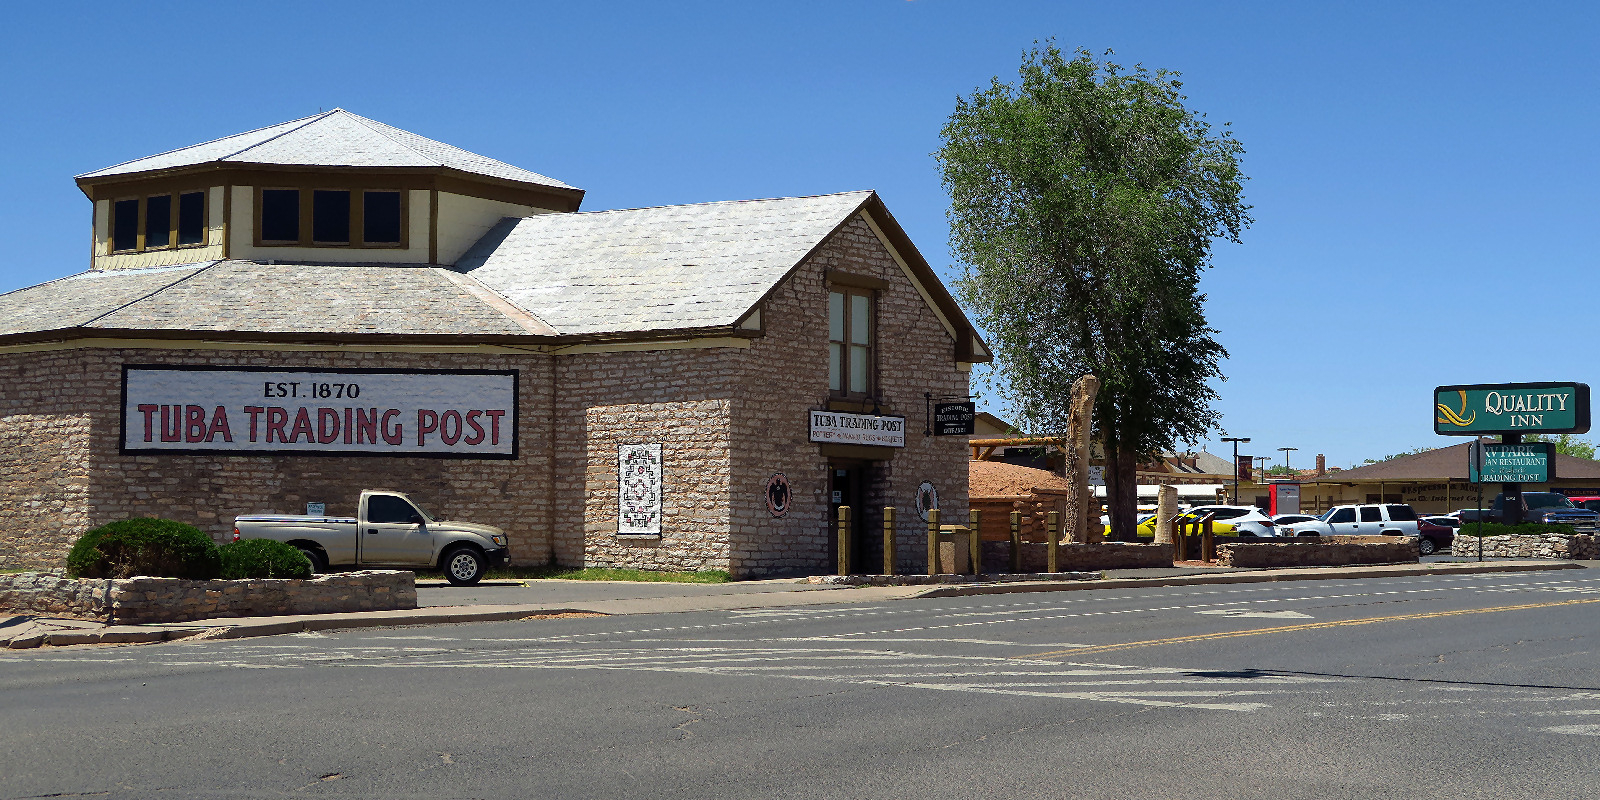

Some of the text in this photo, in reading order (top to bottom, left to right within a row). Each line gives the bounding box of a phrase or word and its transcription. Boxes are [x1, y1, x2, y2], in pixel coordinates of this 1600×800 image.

[264, 382, 360, 399] EST. 1870
[1485, 391, 1570, 416] QUALITY
[138, 404, 506, 447] TUBA TRADING POST
[814, 414, 903, 432] TUBA TRADING POST
[1510, 414, 1544, 427] INN
[1501, 445, 1536, 457] PARK
[1500, 457, 1546, 466] RESTAURANT
[1481, 473, 1540, 482] TRADING POST
